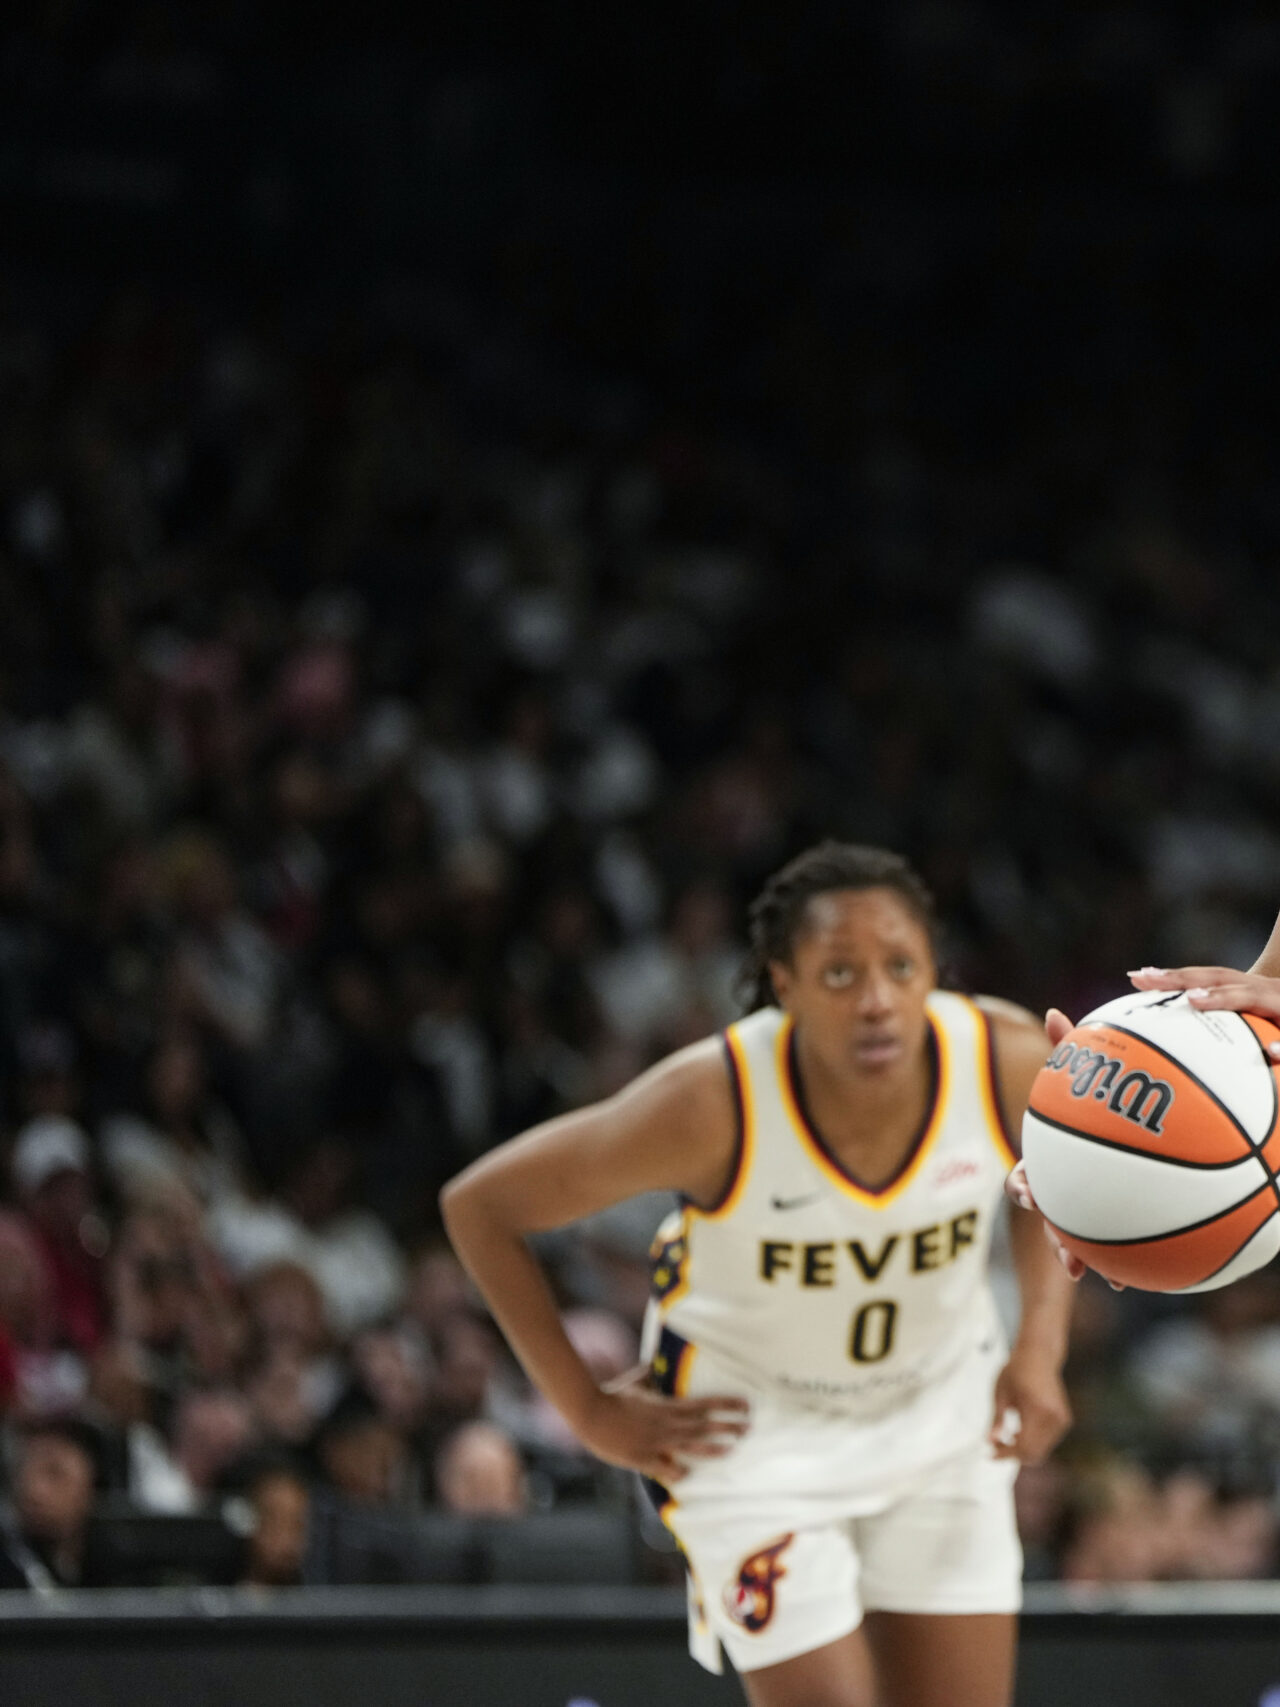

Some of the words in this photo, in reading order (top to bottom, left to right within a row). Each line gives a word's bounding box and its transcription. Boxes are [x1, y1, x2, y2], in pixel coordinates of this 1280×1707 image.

[1046, 1041, 1175, 1136] Wilso
[759, 1209, 979, 1288] FEVER
[848, 1299, 897, 1366] 0
